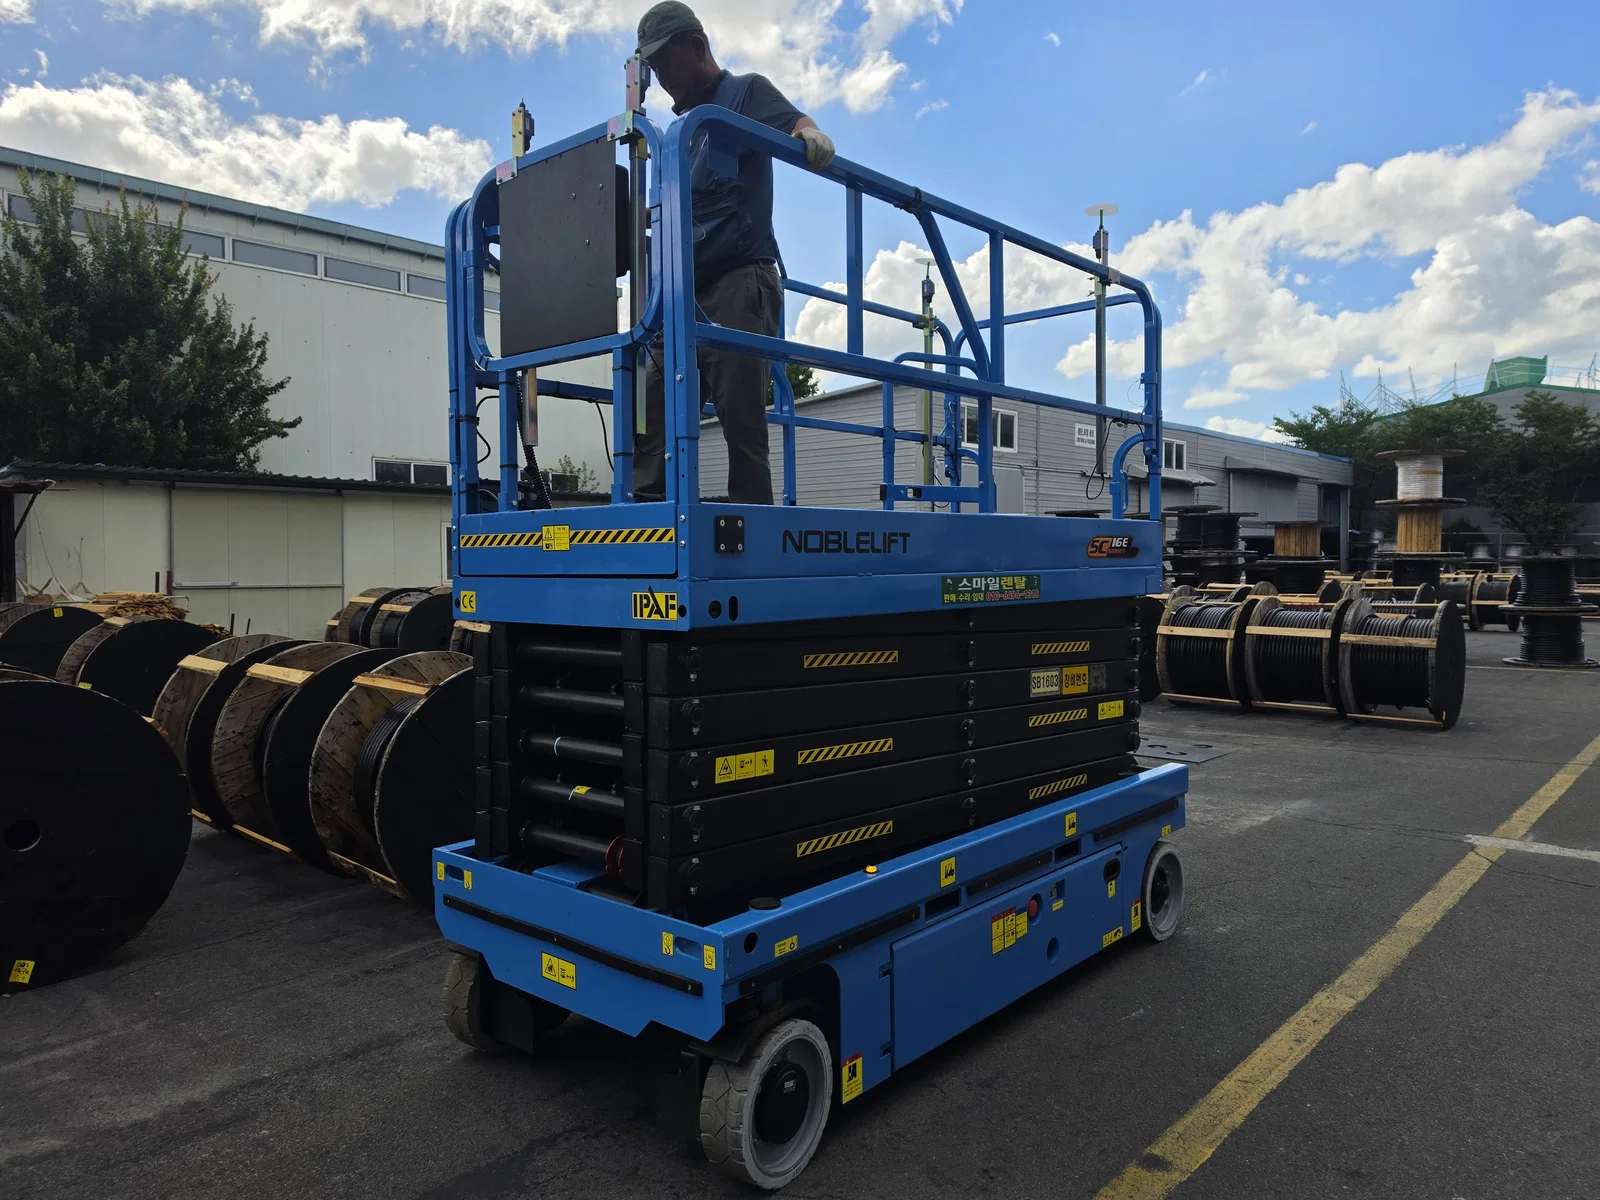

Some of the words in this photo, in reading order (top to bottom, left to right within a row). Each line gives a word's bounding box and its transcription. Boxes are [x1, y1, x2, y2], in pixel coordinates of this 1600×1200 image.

[782, 530, 911, 554] NOBLELIFT
[1089, 539, 1110, 554] SC
[1111, 537, 1129, 548] 16E
[957, 576, 1027, 591] 스마일렌탈
[462, 594, 474, 609] CE
[633, 585, 676, 618] IPAF
[1032, 674, 1059, 689] SB1603
[1064, 673, 1087, 688] 장비번호
